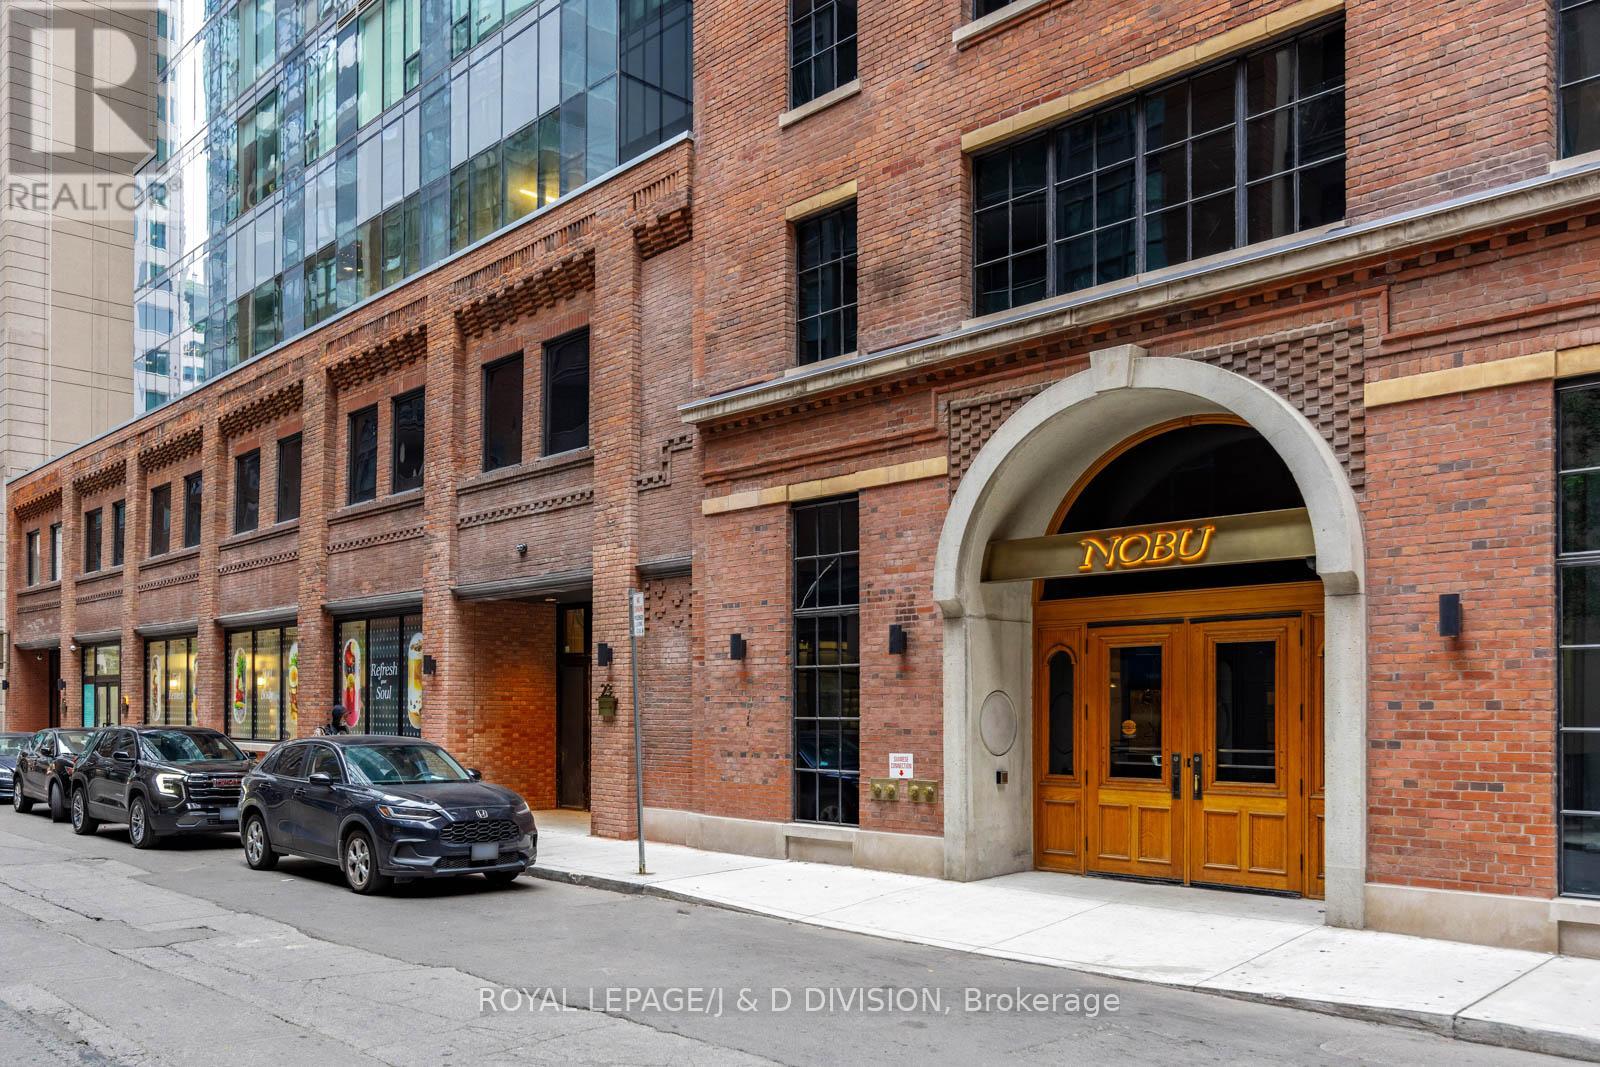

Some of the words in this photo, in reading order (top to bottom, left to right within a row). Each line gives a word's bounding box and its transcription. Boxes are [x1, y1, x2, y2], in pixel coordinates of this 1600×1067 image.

[1078, 525, 1216, 571] NOBU
[371, 661, 398, 680] Refresh
[376, 685, 392, 699] Soul
[600, 683, 613, 697] 23
